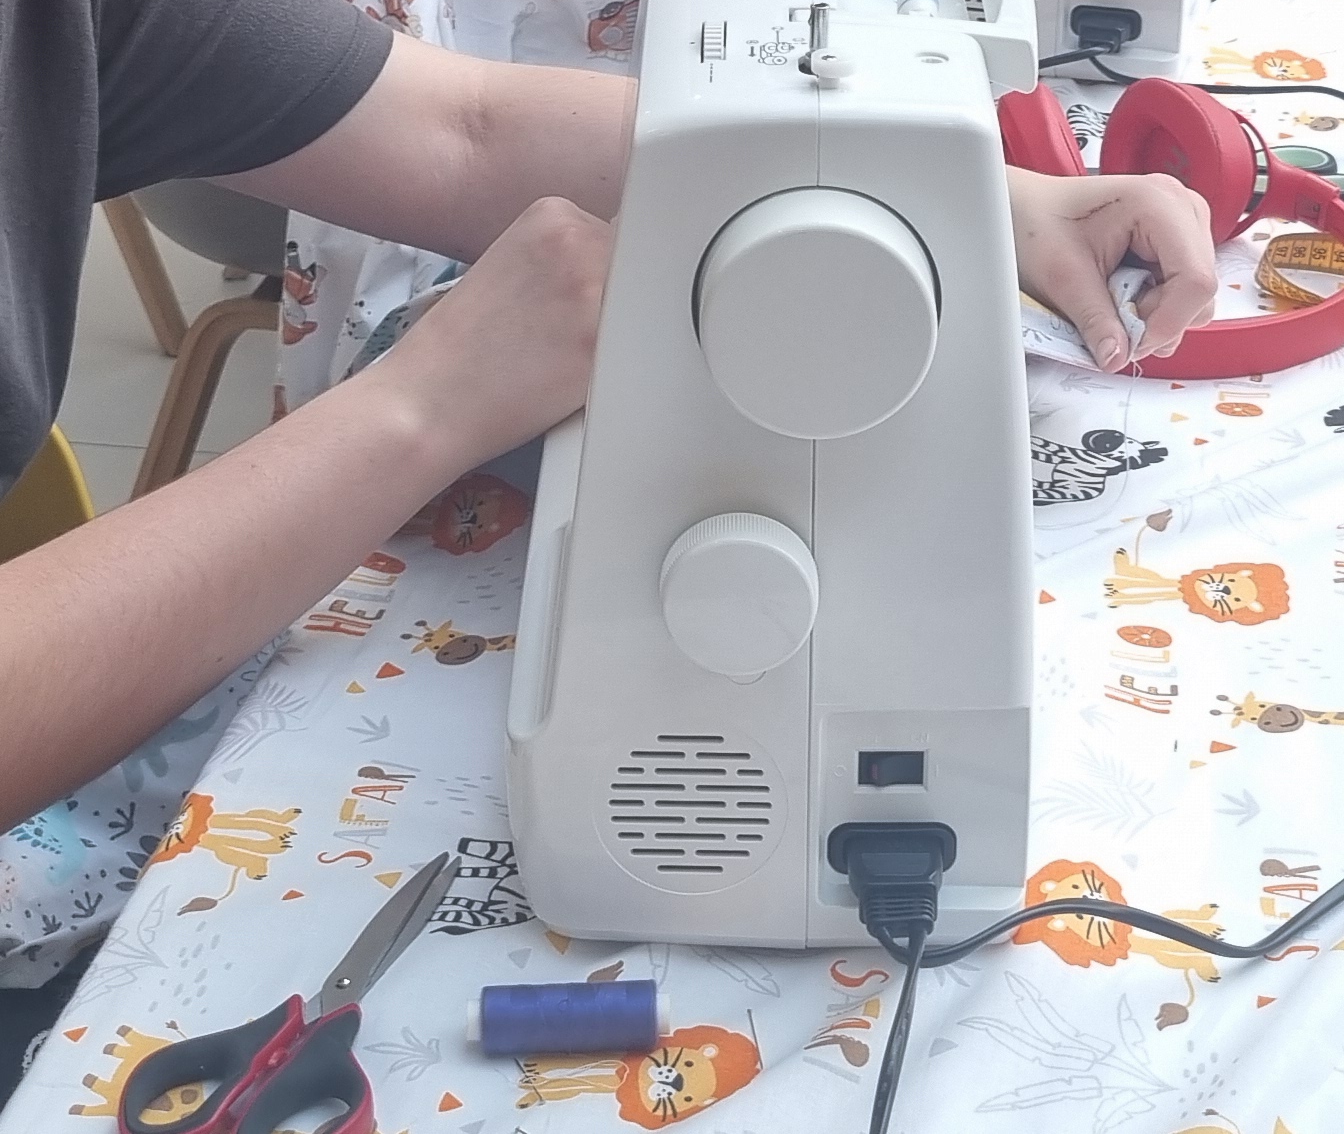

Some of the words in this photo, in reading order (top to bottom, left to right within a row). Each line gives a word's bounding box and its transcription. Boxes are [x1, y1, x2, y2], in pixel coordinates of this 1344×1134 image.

[302, 551, 407, 637] HELLO
[1104, 624, 1179, 716] HELLO
[317, 759, 423, 869] SAFARI
